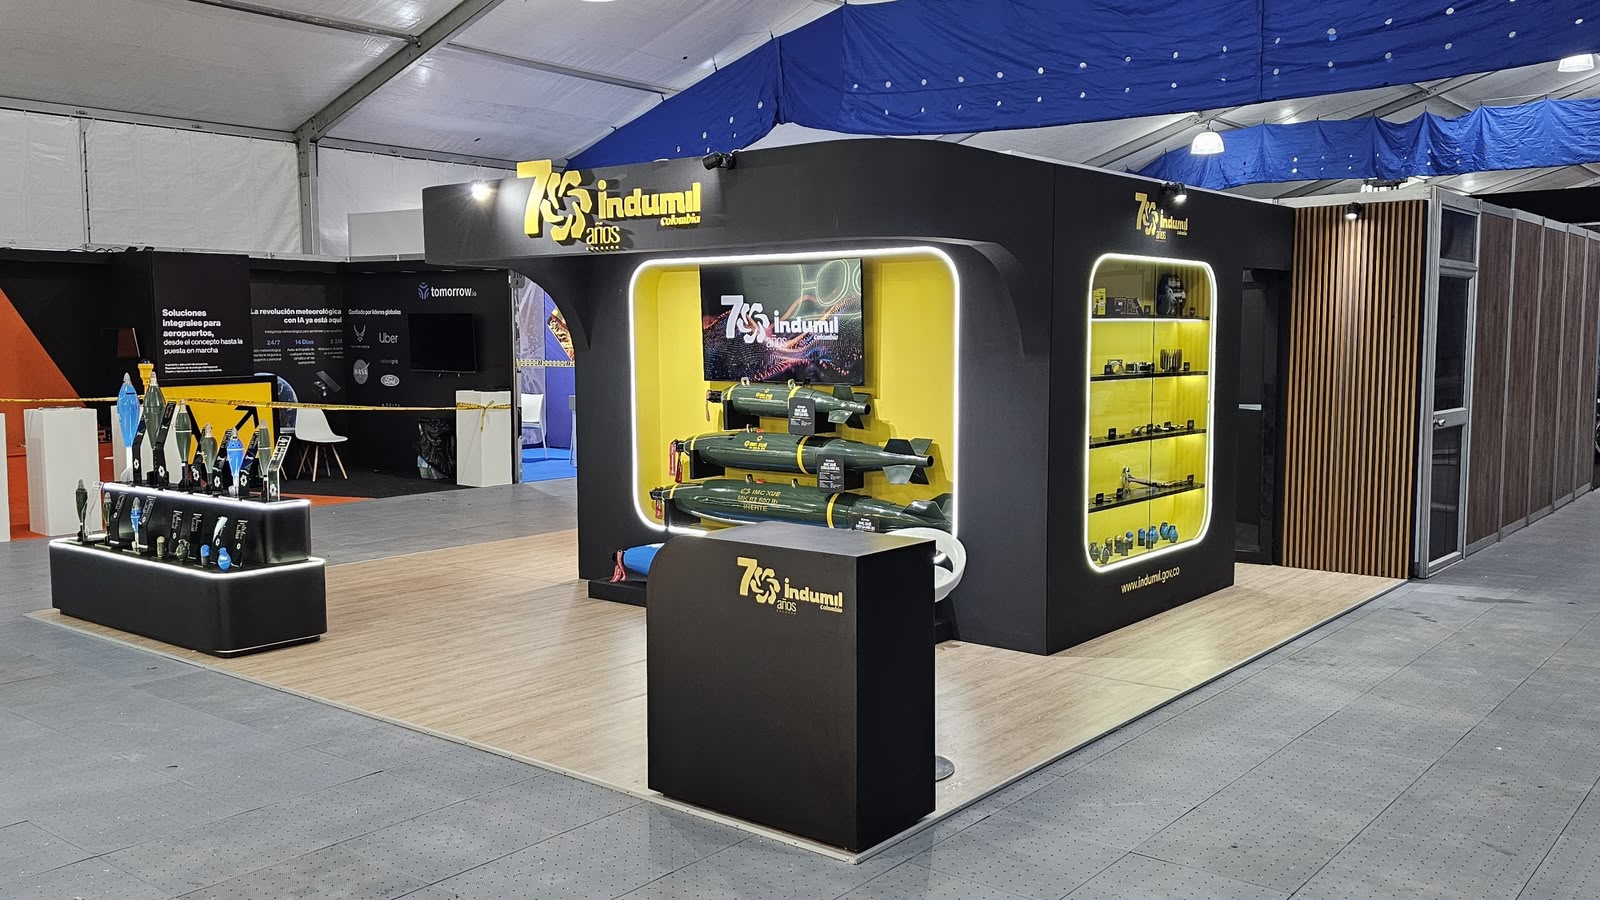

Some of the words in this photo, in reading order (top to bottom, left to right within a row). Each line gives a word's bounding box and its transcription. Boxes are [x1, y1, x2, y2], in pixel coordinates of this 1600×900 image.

[598, 179, 701, 219] indumil
[1160, 209, 1188, 230] indumil
[586, 222, 620, 245] años
[431, 286, 477, 297] tomorrow.io
[162, 308, 207, 317] Soluciones
[260, 307, 295, 315] revolución
[296, 307, 341, 316] meteorológica
[162, 319, 203, 328] integrales
[774, 310, 839, 333] indumil
[163, 330, 214, 338] aeropuertos,
[379, 332, 398, 343] Uber
[766, 335, 788, 348] años
[1121, 566, 1180, 593] www.indumil.gov.co
[784, 577, 843, 607] indumil
[776, 597, 797, 612] años
